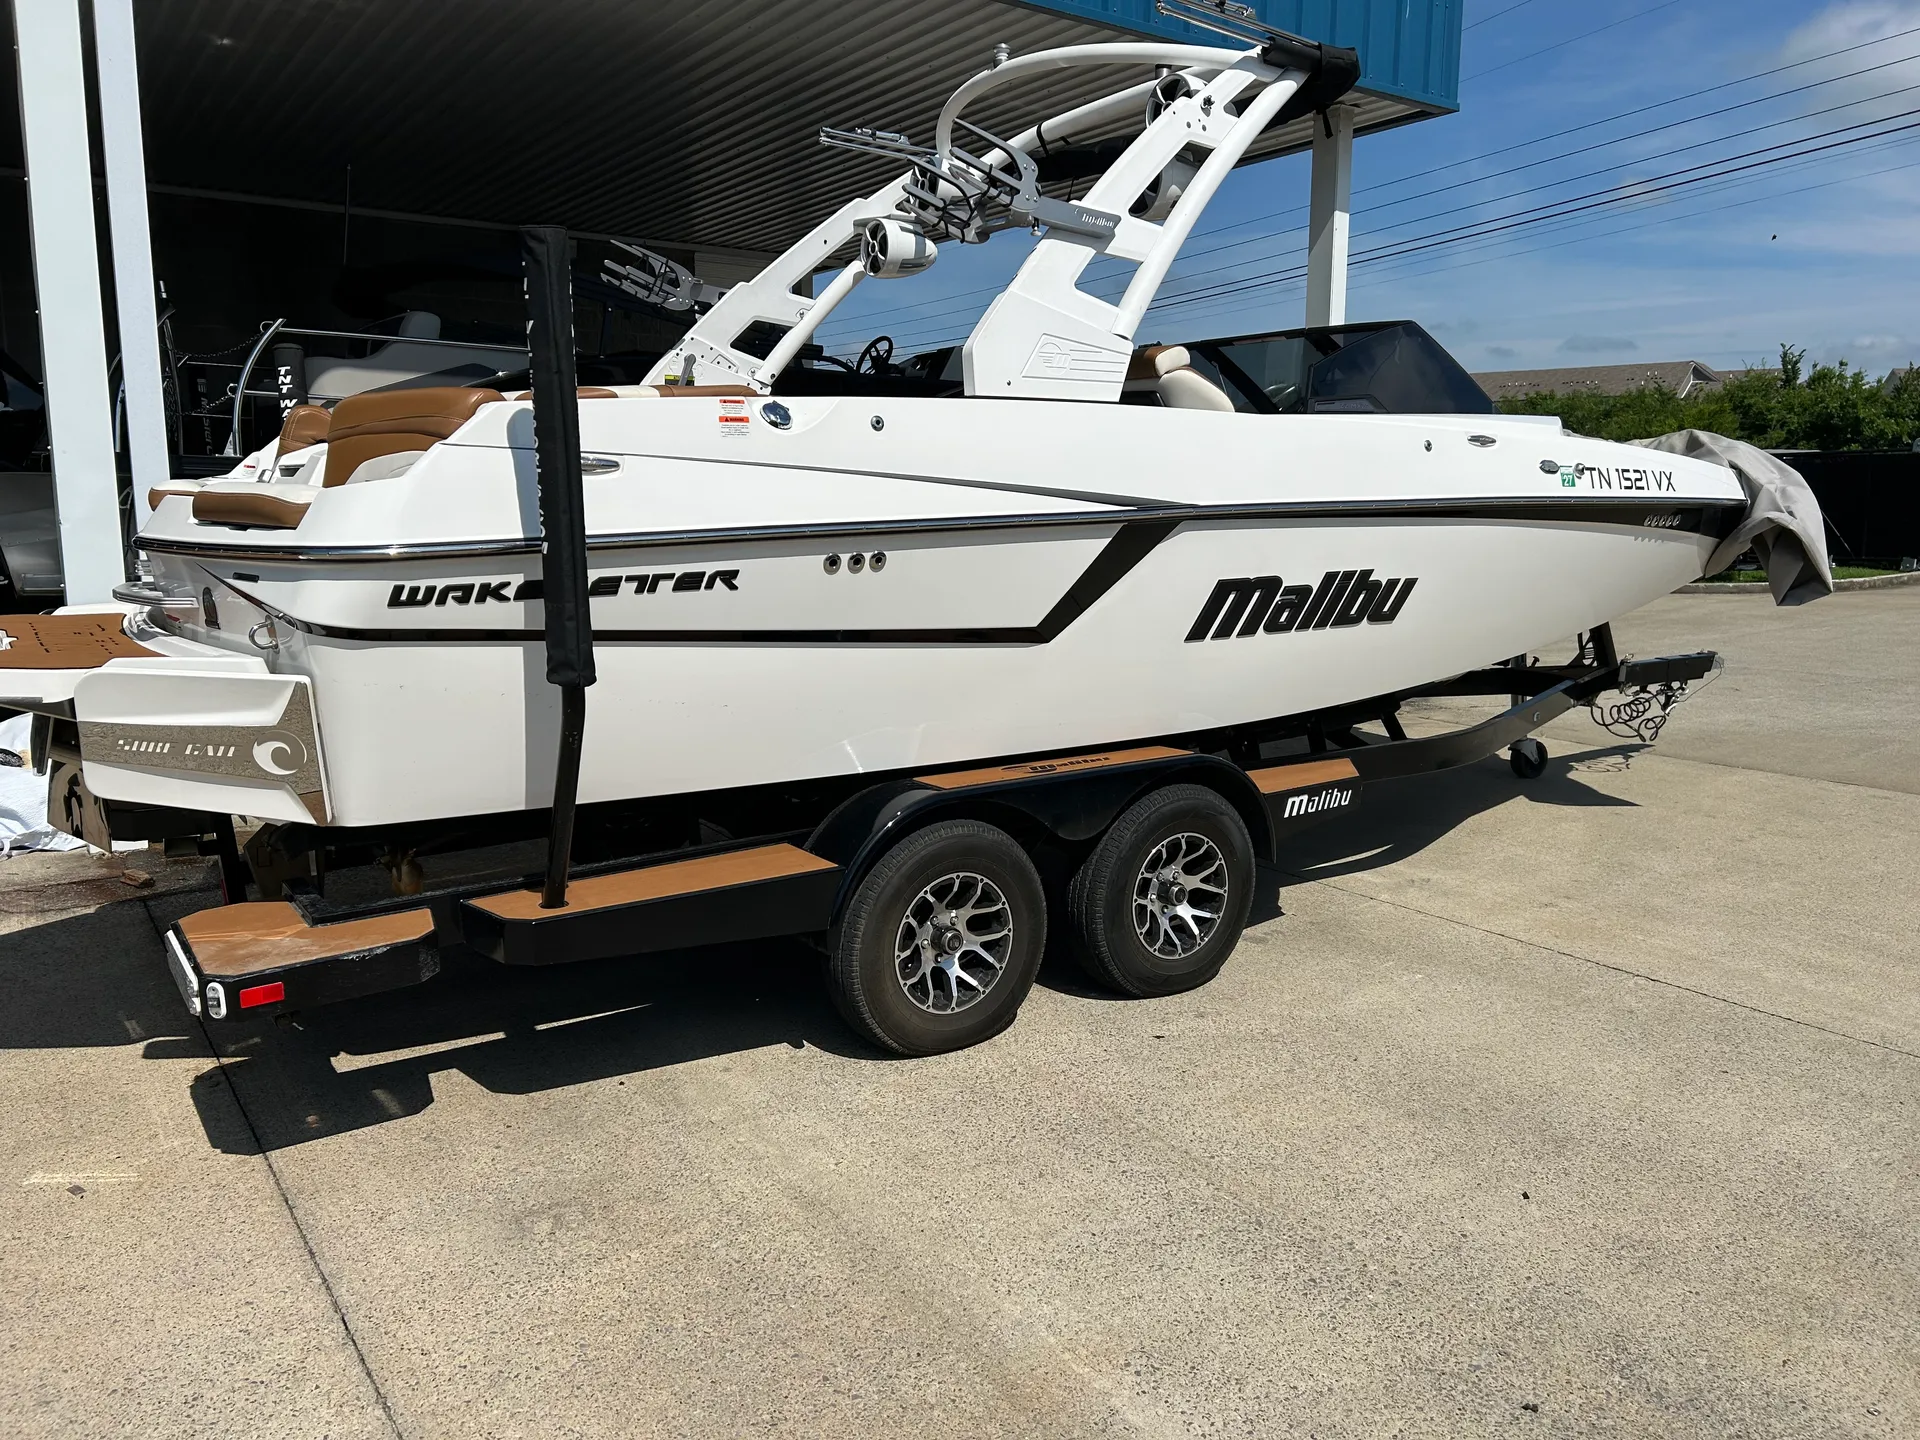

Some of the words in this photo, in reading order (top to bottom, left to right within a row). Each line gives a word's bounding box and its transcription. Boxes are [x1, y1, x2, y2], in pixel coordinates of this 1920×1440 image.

[277, 366, 293, 394] TNT
[279, 398, 298, 421] WA
[1563, 474, 1573, 487] 27
[1585, 466, 1613, 490] TN
[1615, 468, 1651, 491] 1521
[1651, 469, 1677, 492] VX
[386, 568, 741, 608] WAKEETTER
[1283, 788, 1353, 819] Malibu
